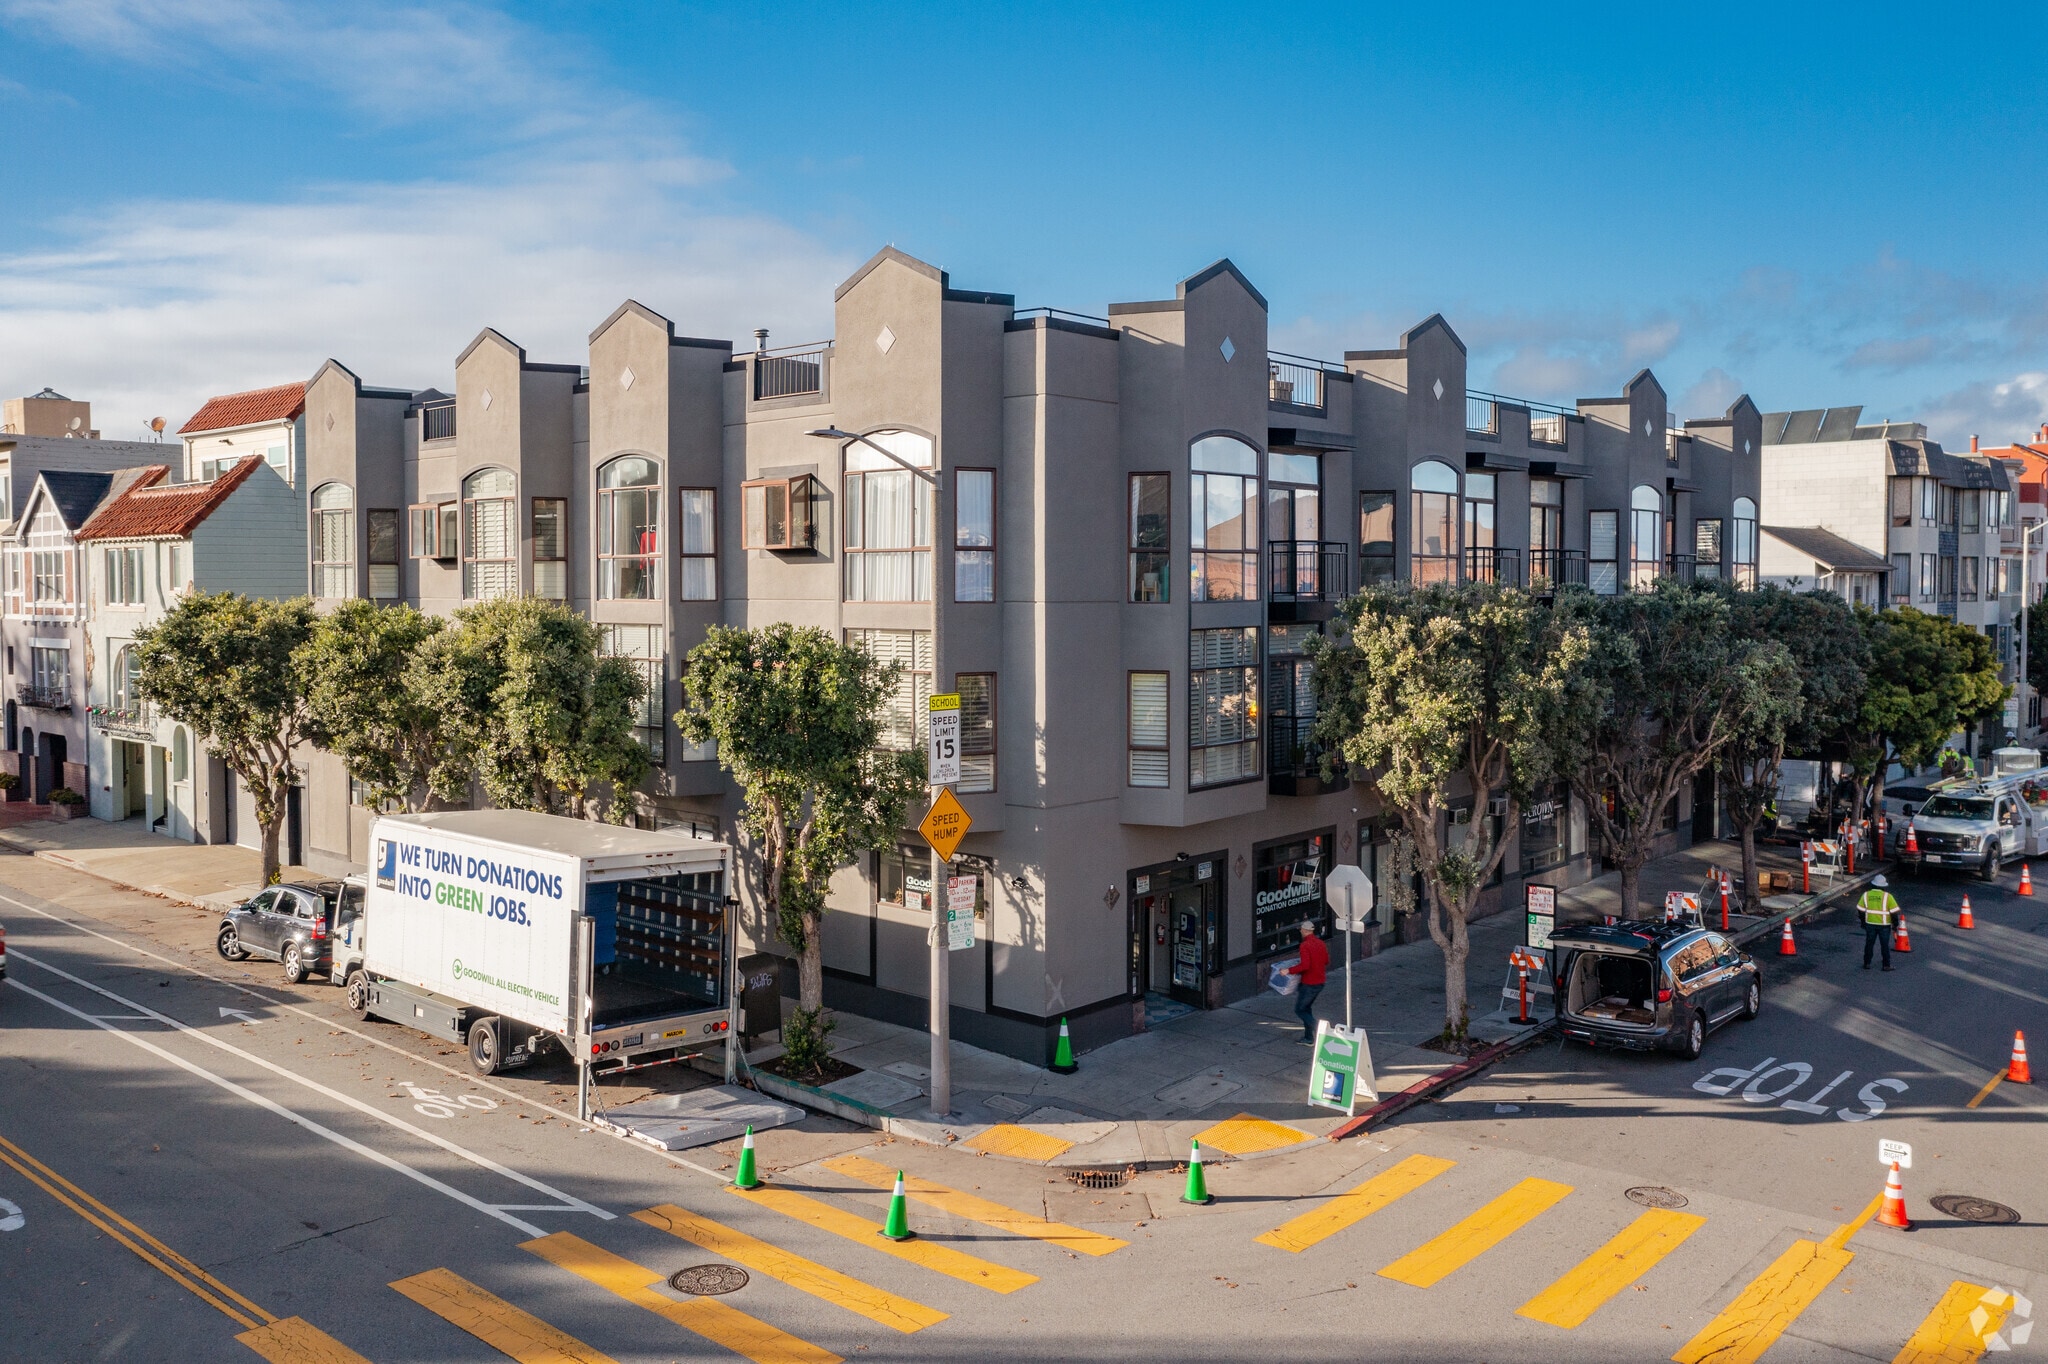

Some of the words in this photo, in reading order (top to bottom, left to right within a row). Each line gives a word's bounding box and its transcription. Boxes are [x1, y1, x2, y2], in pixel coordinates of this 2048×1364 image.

[932, 698, 958, 707] SCHOOL
[932, 716, 958, 726] SPEED
[935, 727, 955, 737] LIMIT
[936, 739, 954, 759] 15
[932, 812, 960, 826] SPEED
[934, 827, 958, 840] HUMP
[400, 843, 421, 867] WE
[425, 848, 462, 876] TURN
[467, 857, 562, 900] DONATIONS
[950, 878, 958, 888] NO
[399, 873, 431, 900] INTO
[436, 882, 483, 914] GREEN
[487, 895, 532, 927] JOBS.
[1256, 880, 1312, 906] Goodwill
[1256, 900, 1287, 915] DONATION
[1288, 895, 1310, 907] CENTER
[949, 912, 954, 920] 2
[464, 968, 494, 986] GOODWILL
[496, 979, 506, 989] ALL
[508, 982, 533, 998] ELECTRIC
[534, 990, 559, 1006] VEHICLE
[1319, 1058, 1354, 1072] Donations
[1692, 1056, 1910, 1122] STOP
[1884, 1152, 1903, 1160] RIGHT
